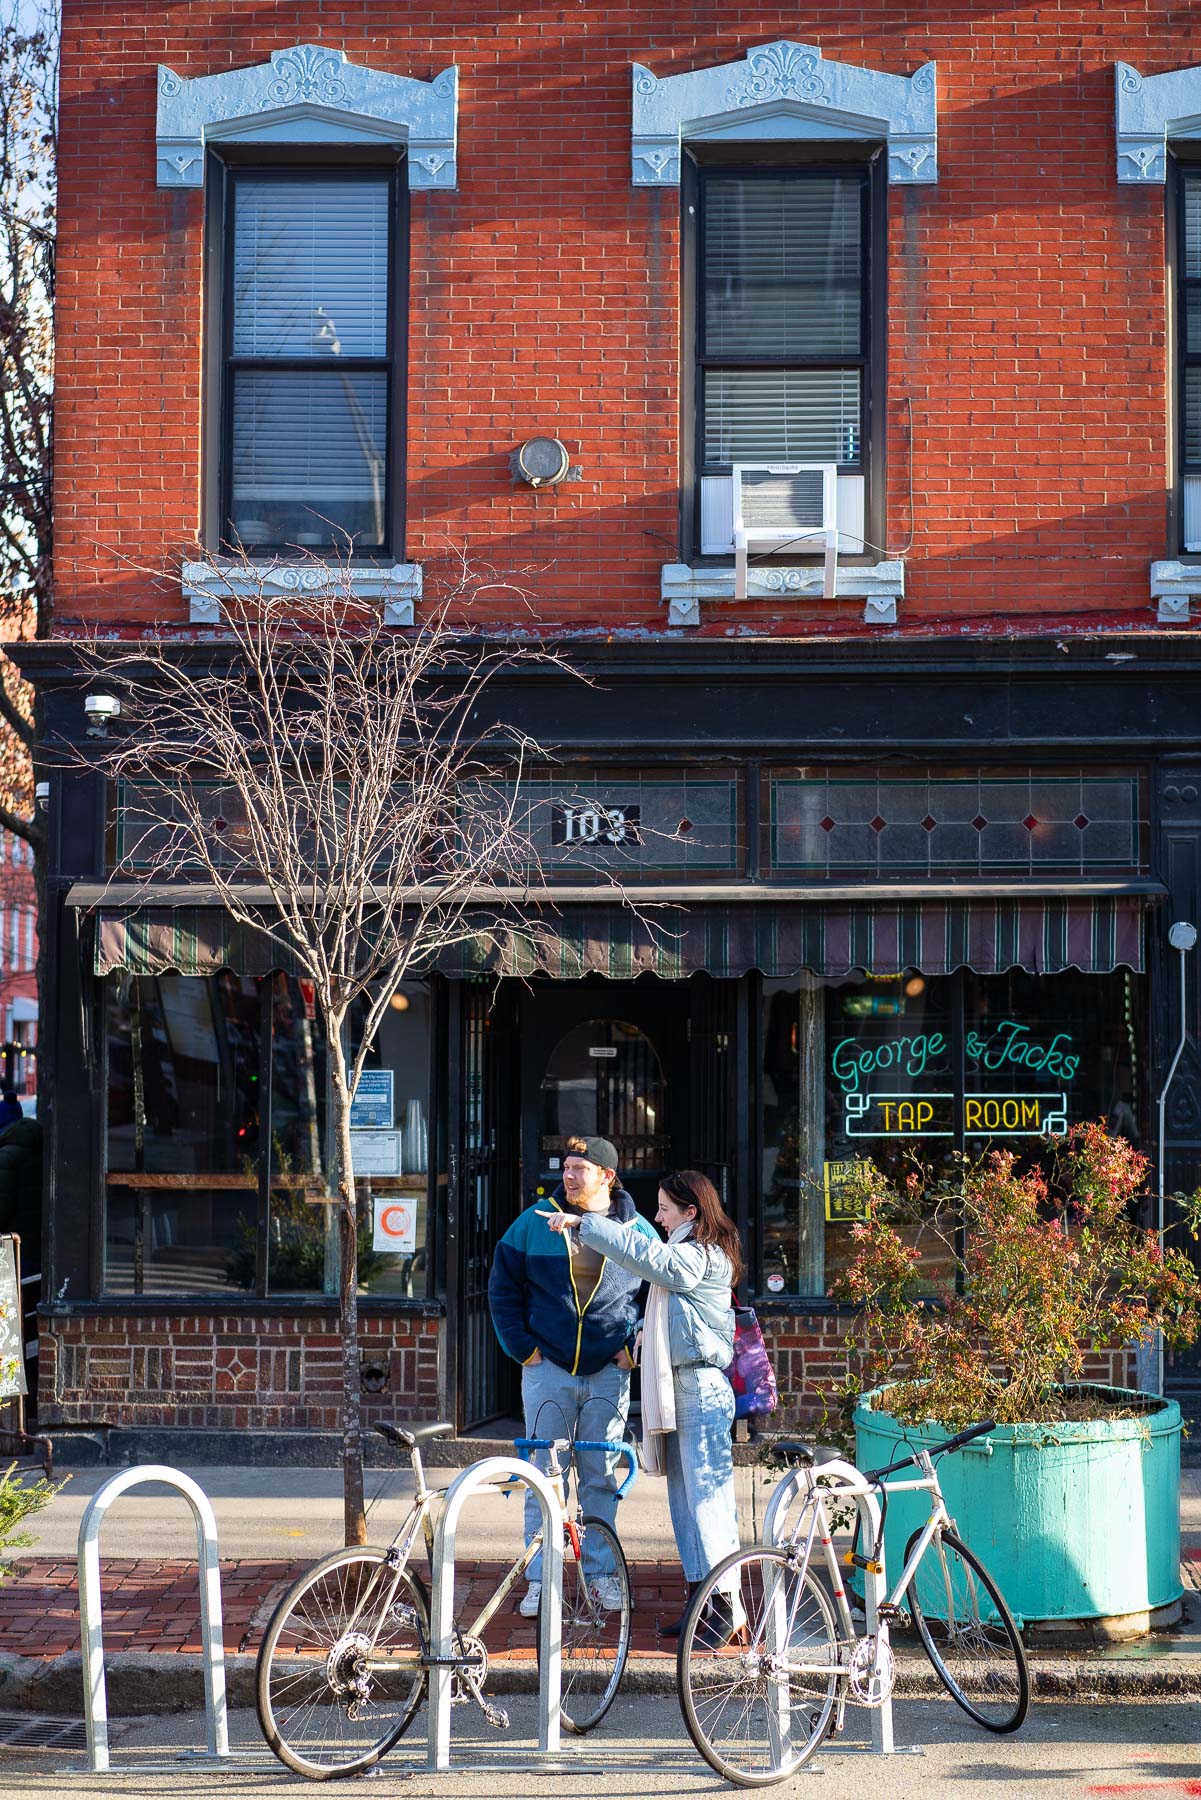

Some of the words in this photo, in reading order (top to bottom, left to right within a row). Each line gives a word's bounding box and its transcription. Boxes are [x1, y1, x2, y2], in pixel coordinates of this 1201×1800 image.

[563, 809, 626, 842] 103
[832, 1032, 947, 1093] George
[966, 1031, 987, 1059] &
[984, 1020, 1080, 1080] Jacks
[877, 1101, 934, 1131] TAP
[965, 1099, 1040, 1129] ROOM
[381, 1205, 405, 1236] C
